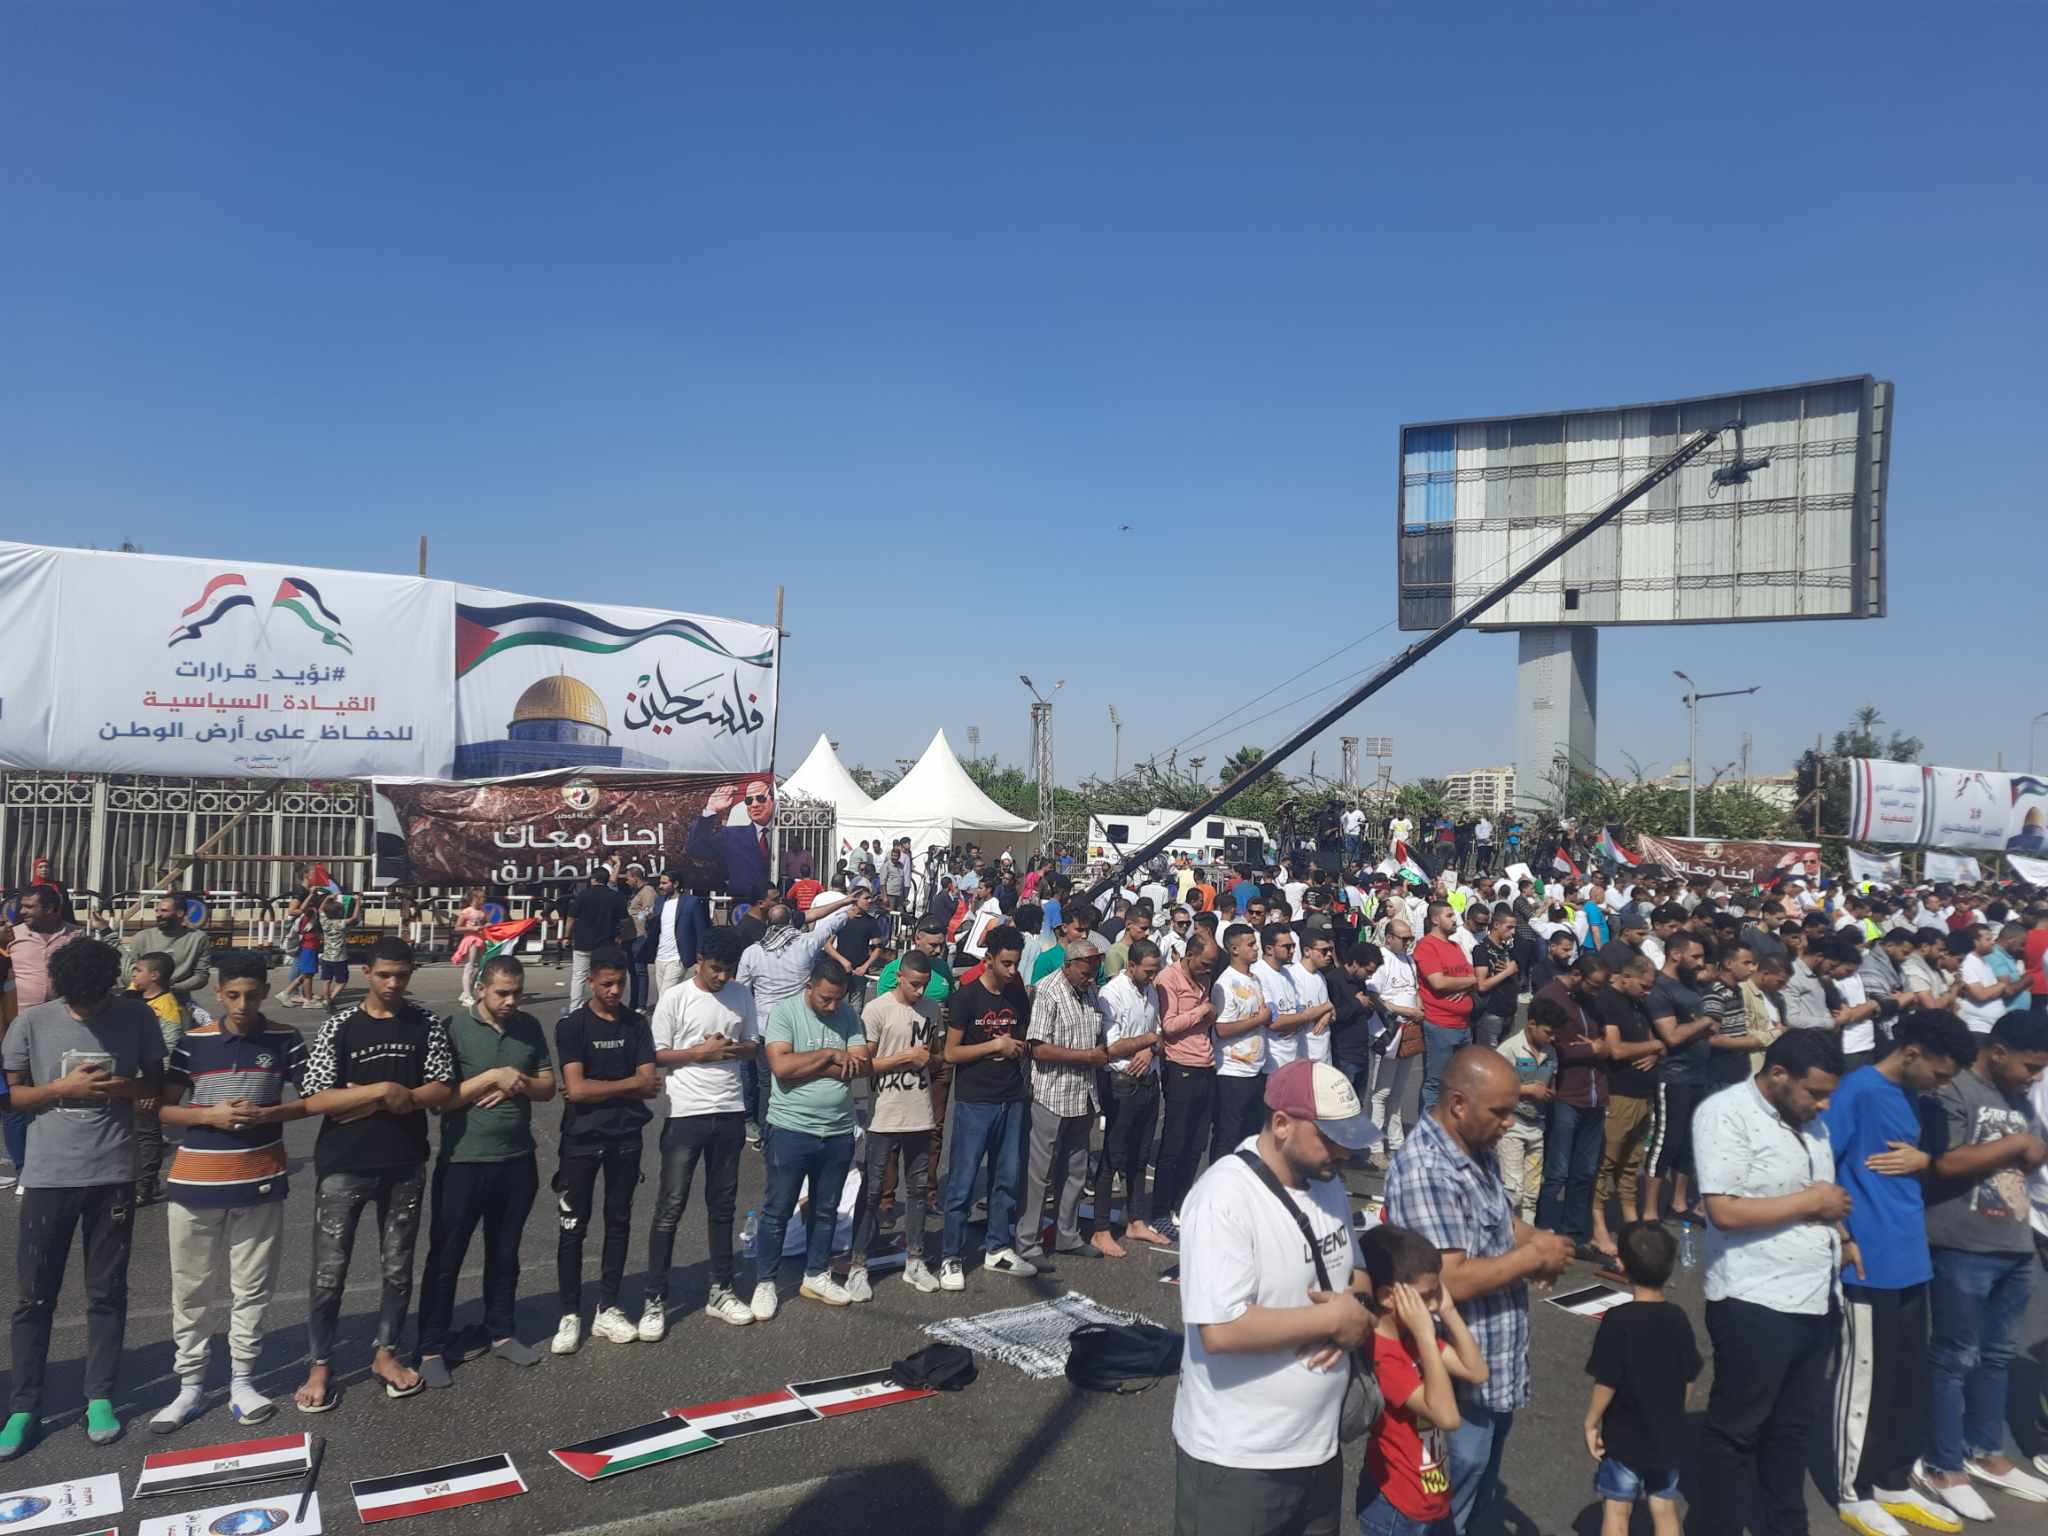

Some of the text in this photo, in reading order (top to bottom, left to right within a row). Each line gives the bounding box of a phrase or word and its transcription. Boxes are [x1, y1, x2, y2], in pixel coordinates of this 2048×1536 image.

[624, 658, 764, 739] فلسطين
[493, 822, 665, 851] إحنا معاك
